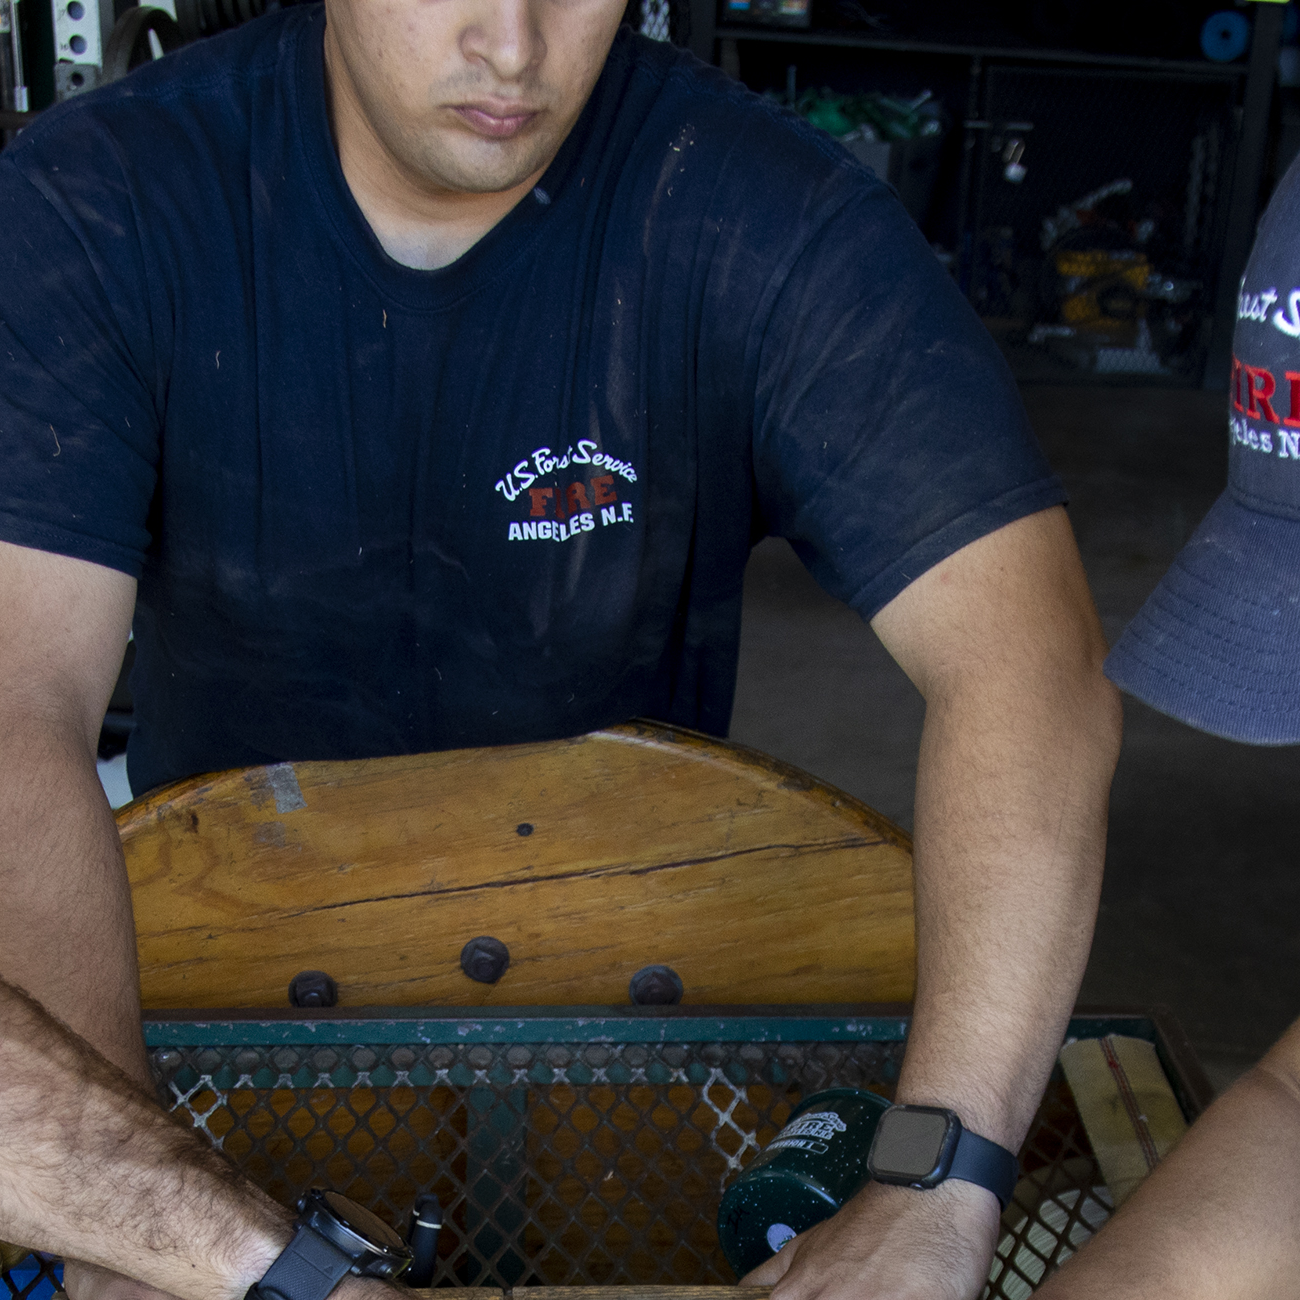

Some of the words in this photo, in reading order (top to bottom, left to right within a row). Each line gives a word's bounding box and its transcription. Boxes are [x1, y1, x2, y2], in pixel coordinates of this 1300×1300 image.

[495, 460, 538, 501] U.S.
[572, 438, 638, 484] Service
[528, 475, 618, 519] FIRE
[508, 512, 596, 542] ANGELES
